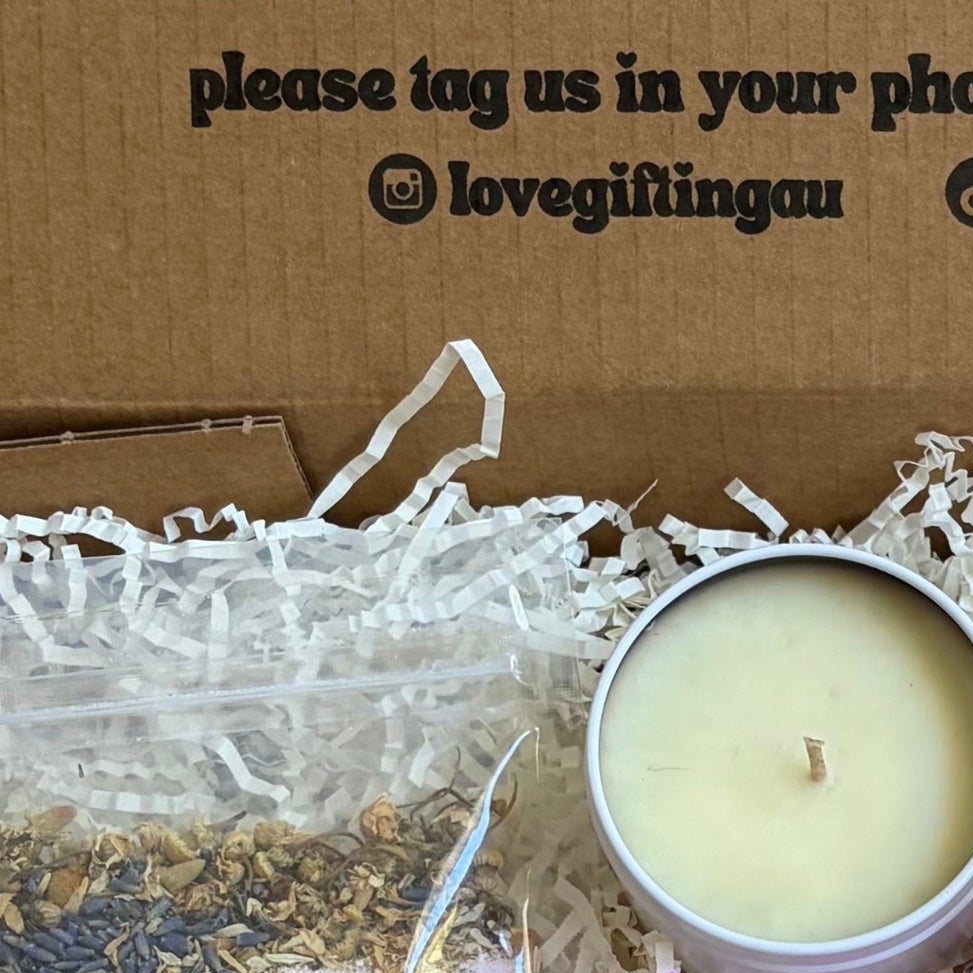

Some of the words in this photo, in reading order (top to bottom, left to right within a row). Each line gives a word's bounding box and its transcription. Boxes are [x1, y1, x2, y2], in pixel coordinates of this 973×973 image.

[190, 51, 396, 127] please
[410, 55, 509, 130] tag
[524, 70, 601, 113] us
[615, 52, 684, 112] in
[698, 71, 856, 131] your
[448, 161, 843, 234] lovegiftingau
